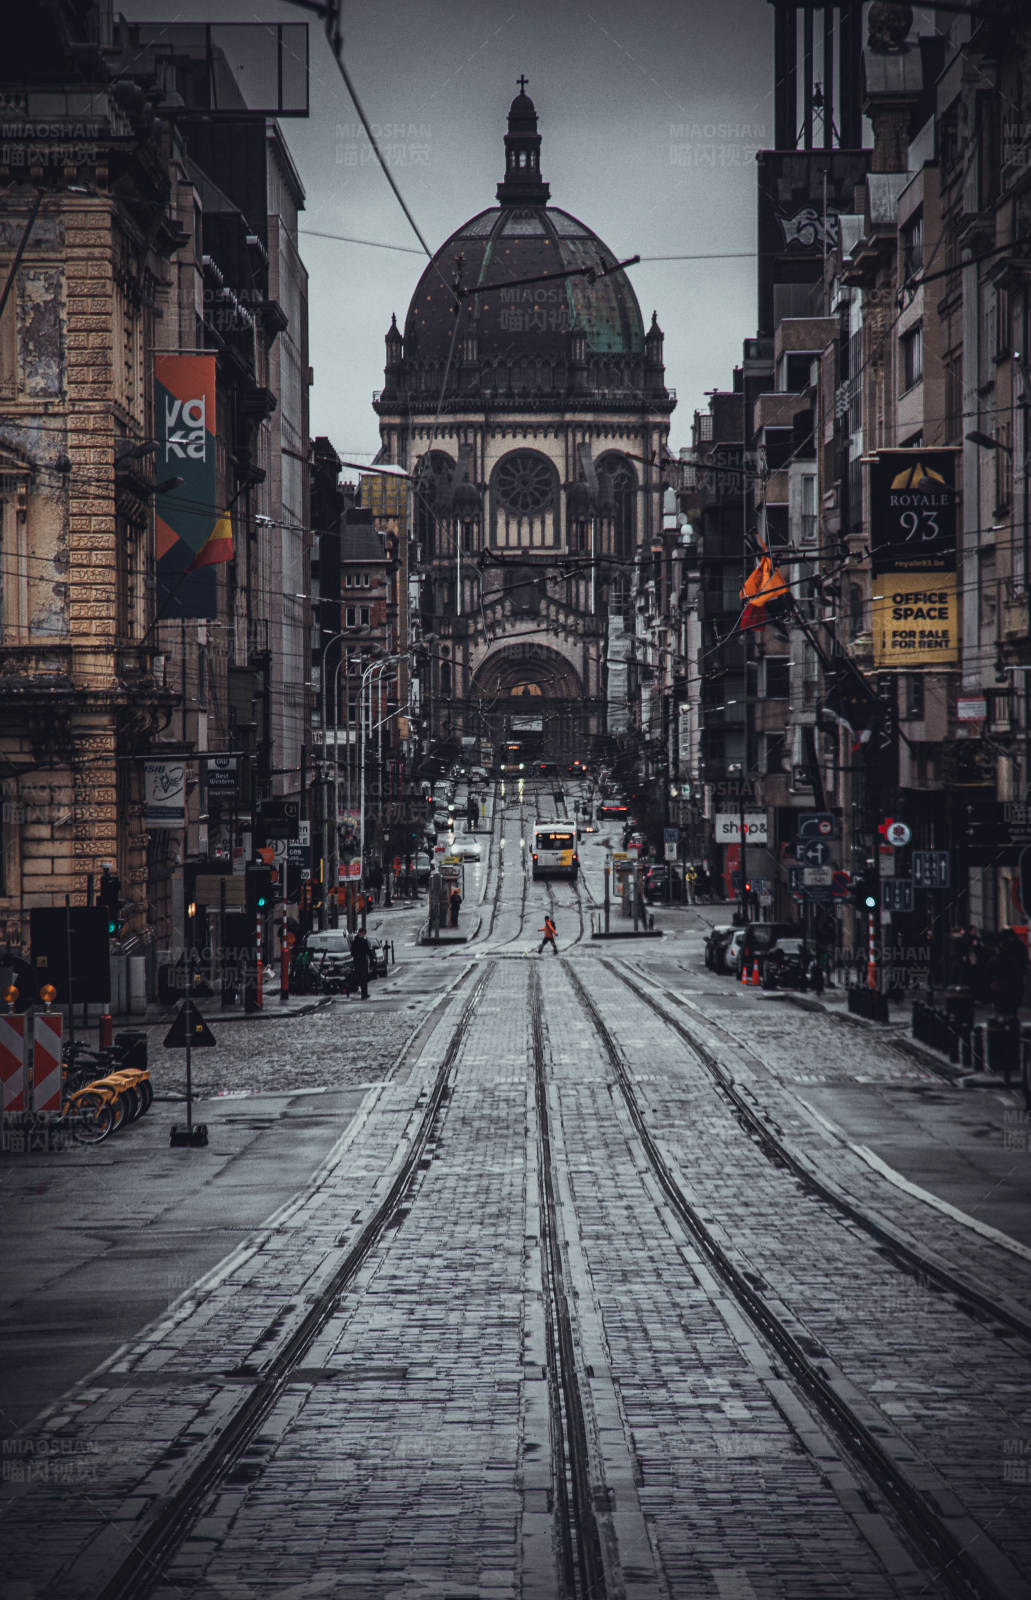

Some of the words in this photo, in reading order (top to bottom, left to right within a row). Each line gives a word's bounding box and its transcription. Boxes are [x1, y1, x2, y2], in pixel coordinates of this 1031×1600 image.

[890, 495, 949, 507] ROYALE
[899, 510, 939, 541] 93
[892, 592, 949, 604] OFFICE
[892, 607, 949, 620] SPACE
[892, 630, 916, 639] FOR
[918, 629, 949, 639] SALE
[892, 640, 916, 649] FOR
[918, 639, 950, 649] RENT
